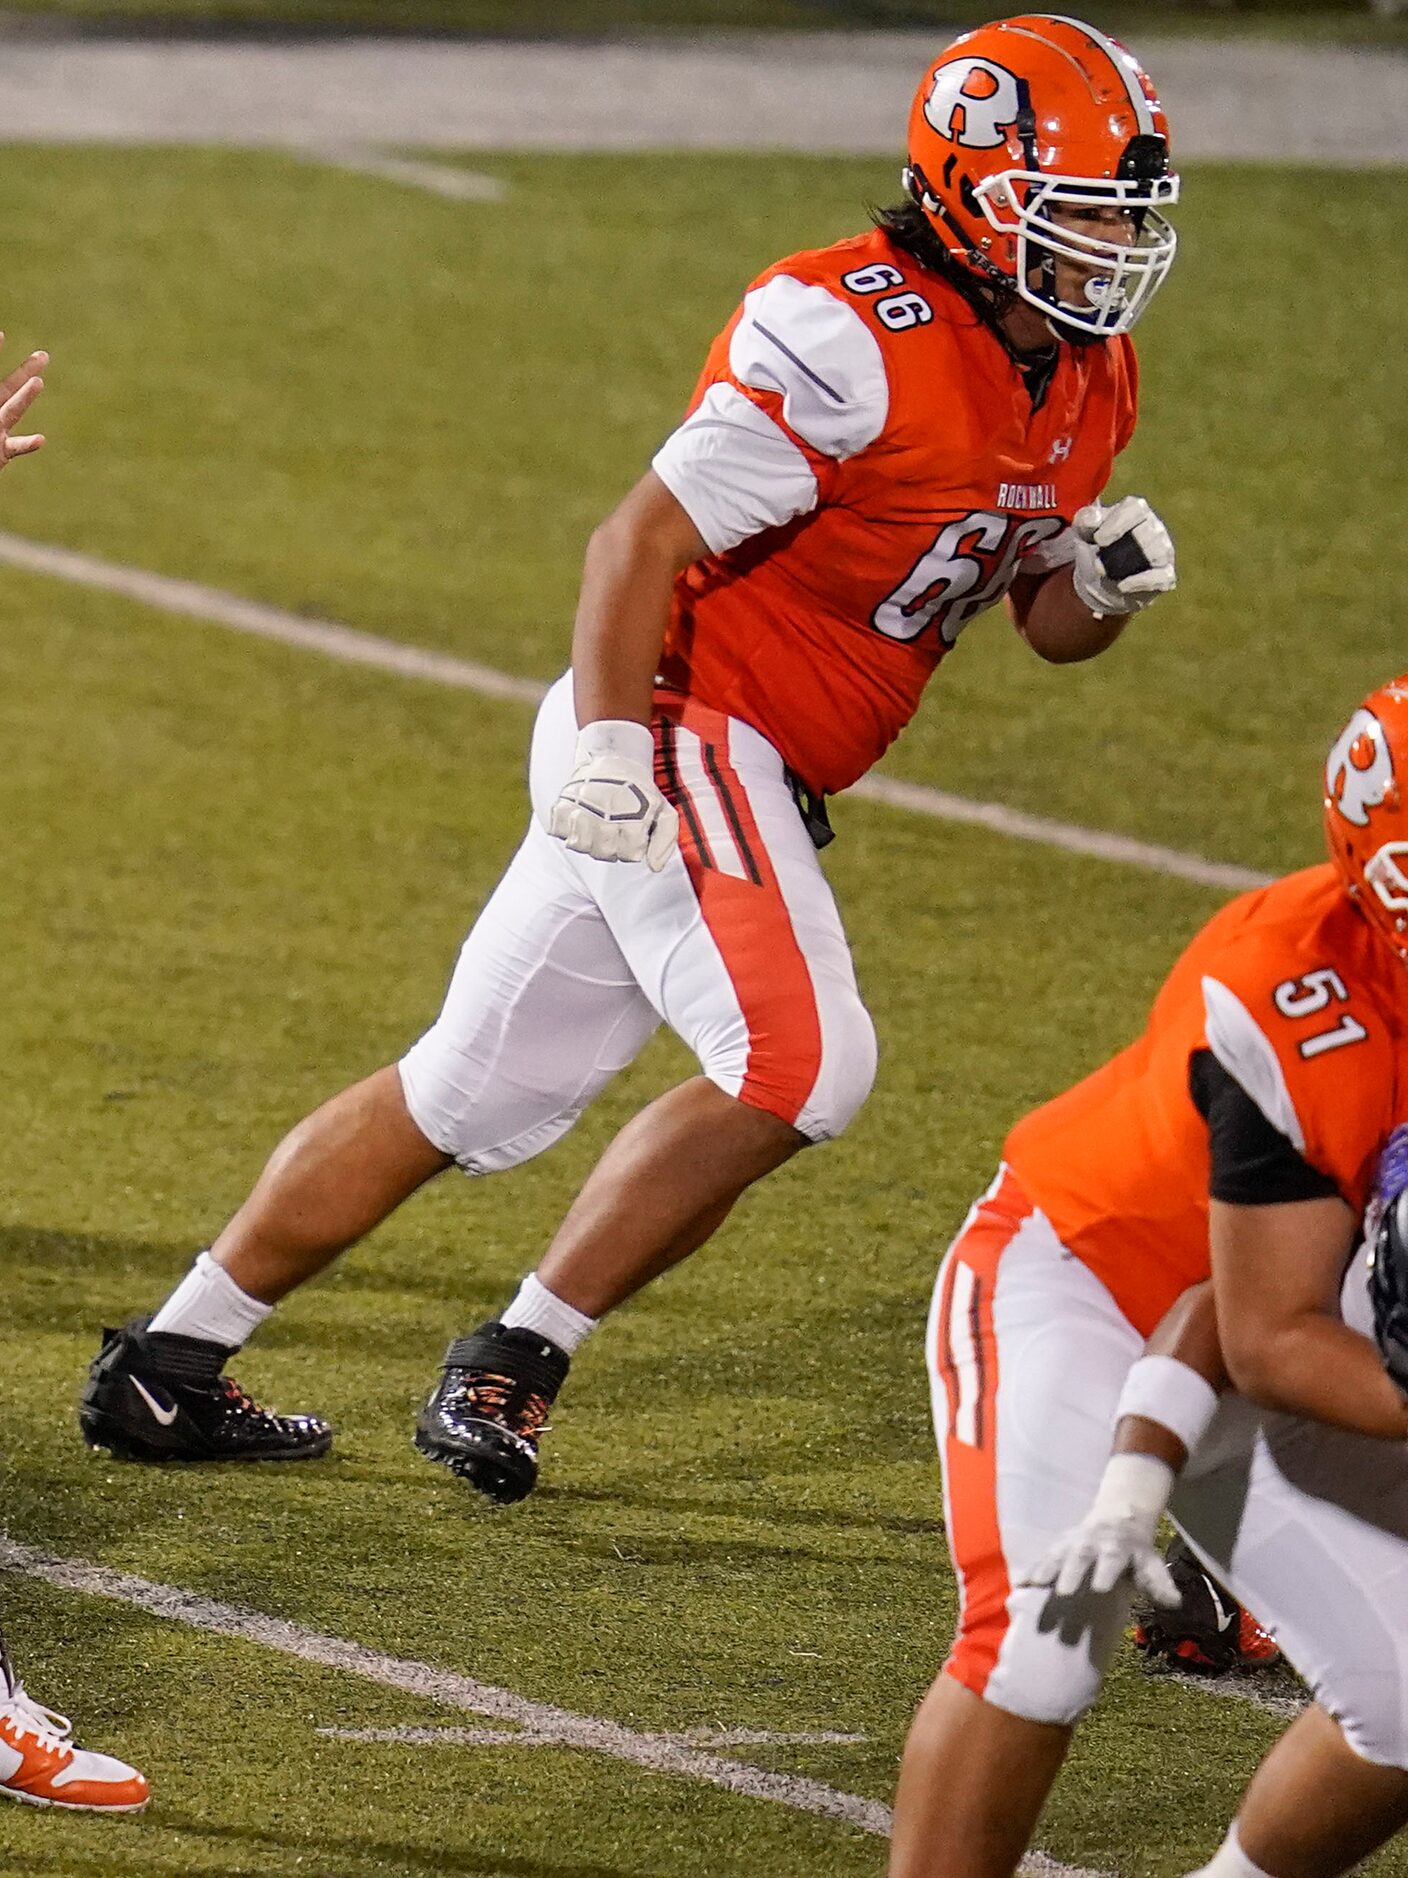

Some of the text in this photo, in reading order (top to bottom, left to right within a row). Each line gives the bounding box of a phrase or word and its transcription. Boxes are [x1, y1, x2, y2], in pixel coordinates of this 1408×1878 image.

[923, 56, 1021, 149] R
[840, 262, 934, 332] 66
[1326, 706, 1395, 827] R
[1274, 967, 1368, 1060] 51
